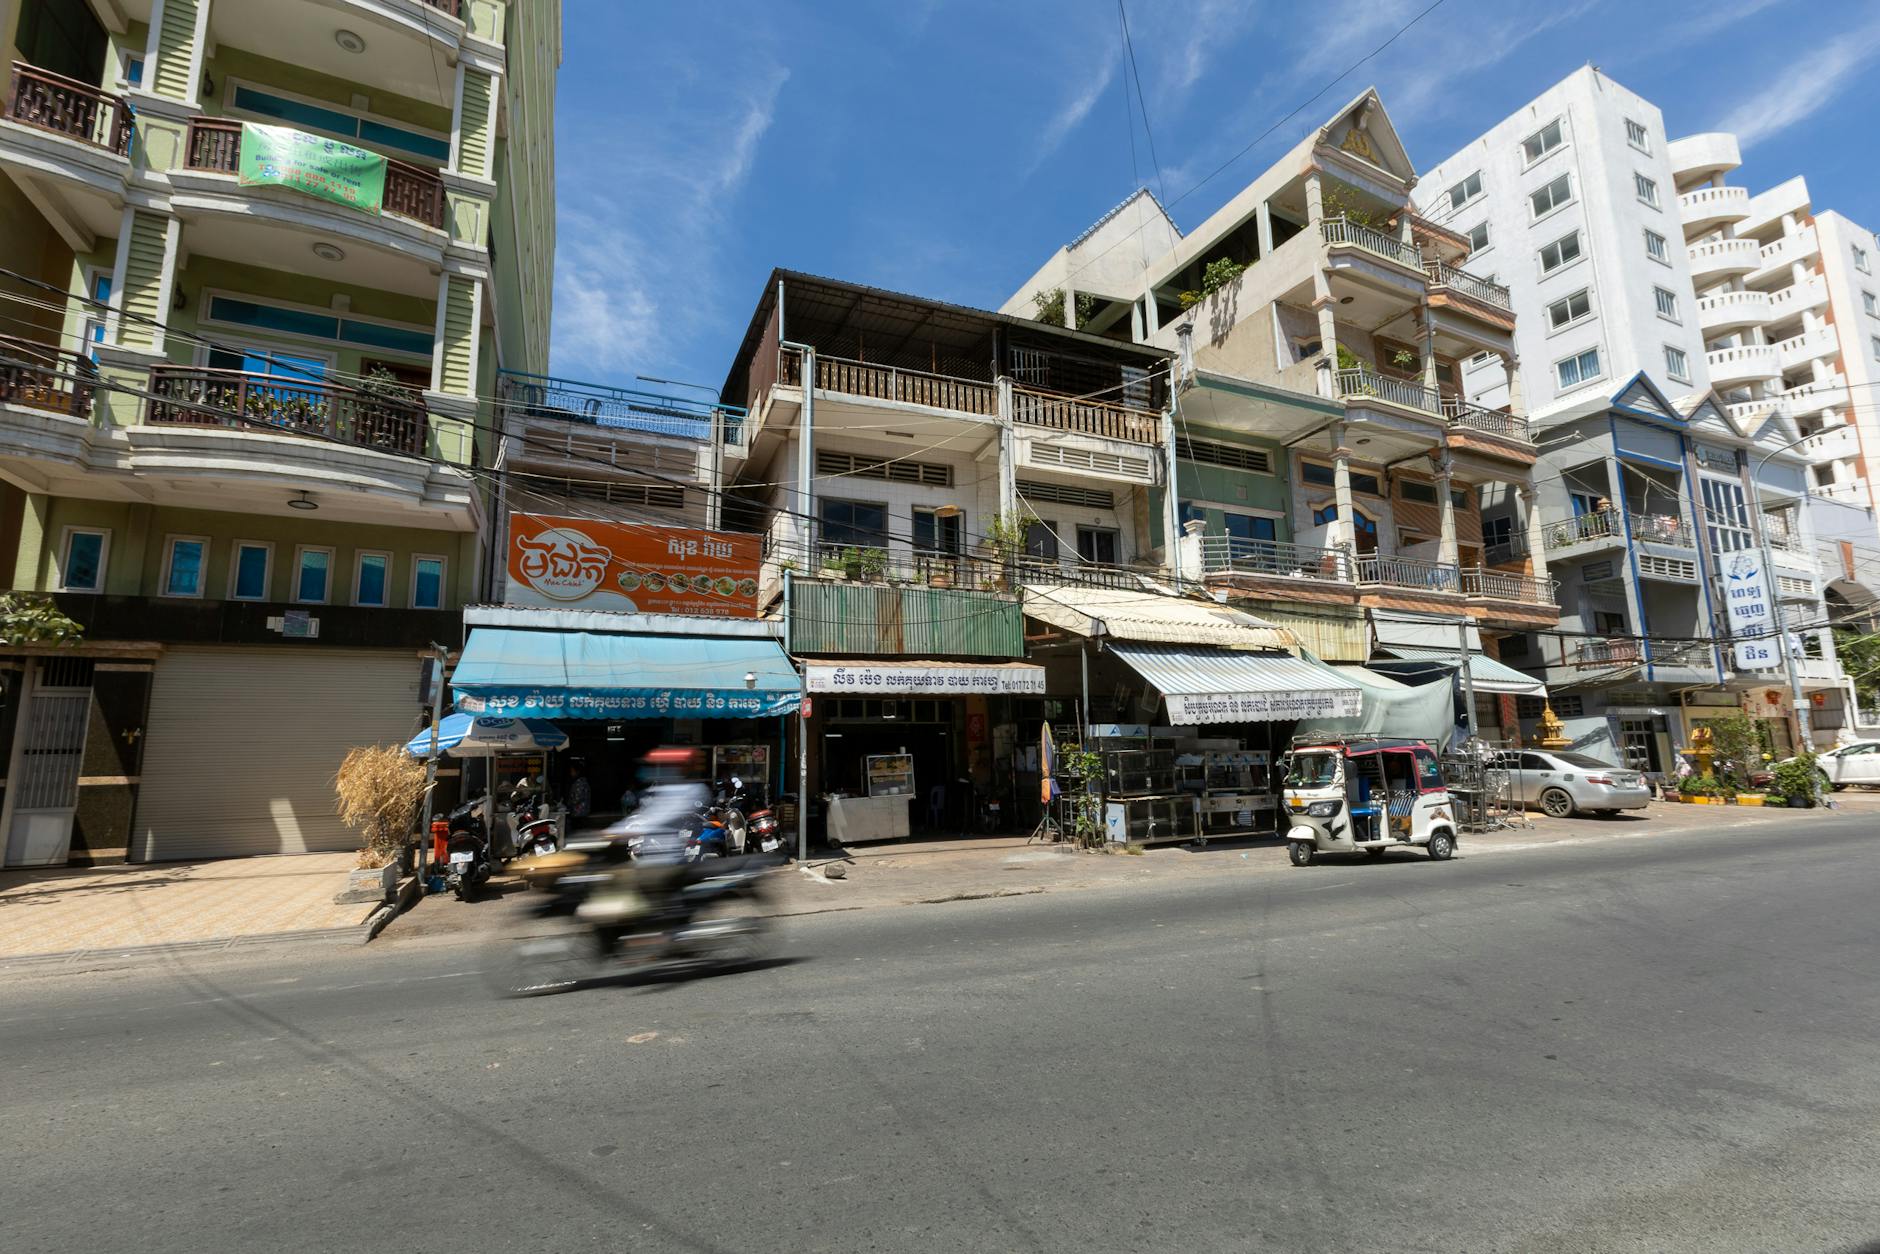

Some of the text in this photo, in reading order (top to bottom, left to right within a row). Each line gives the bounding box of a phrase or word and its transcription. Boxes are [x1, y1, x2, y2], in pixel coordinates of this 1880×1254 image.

[294, 159, 306, 167] for
[309, 164, 329, 174] sale
[330, 171, 341, 179] or
[342, 176, 361, 187] rent
